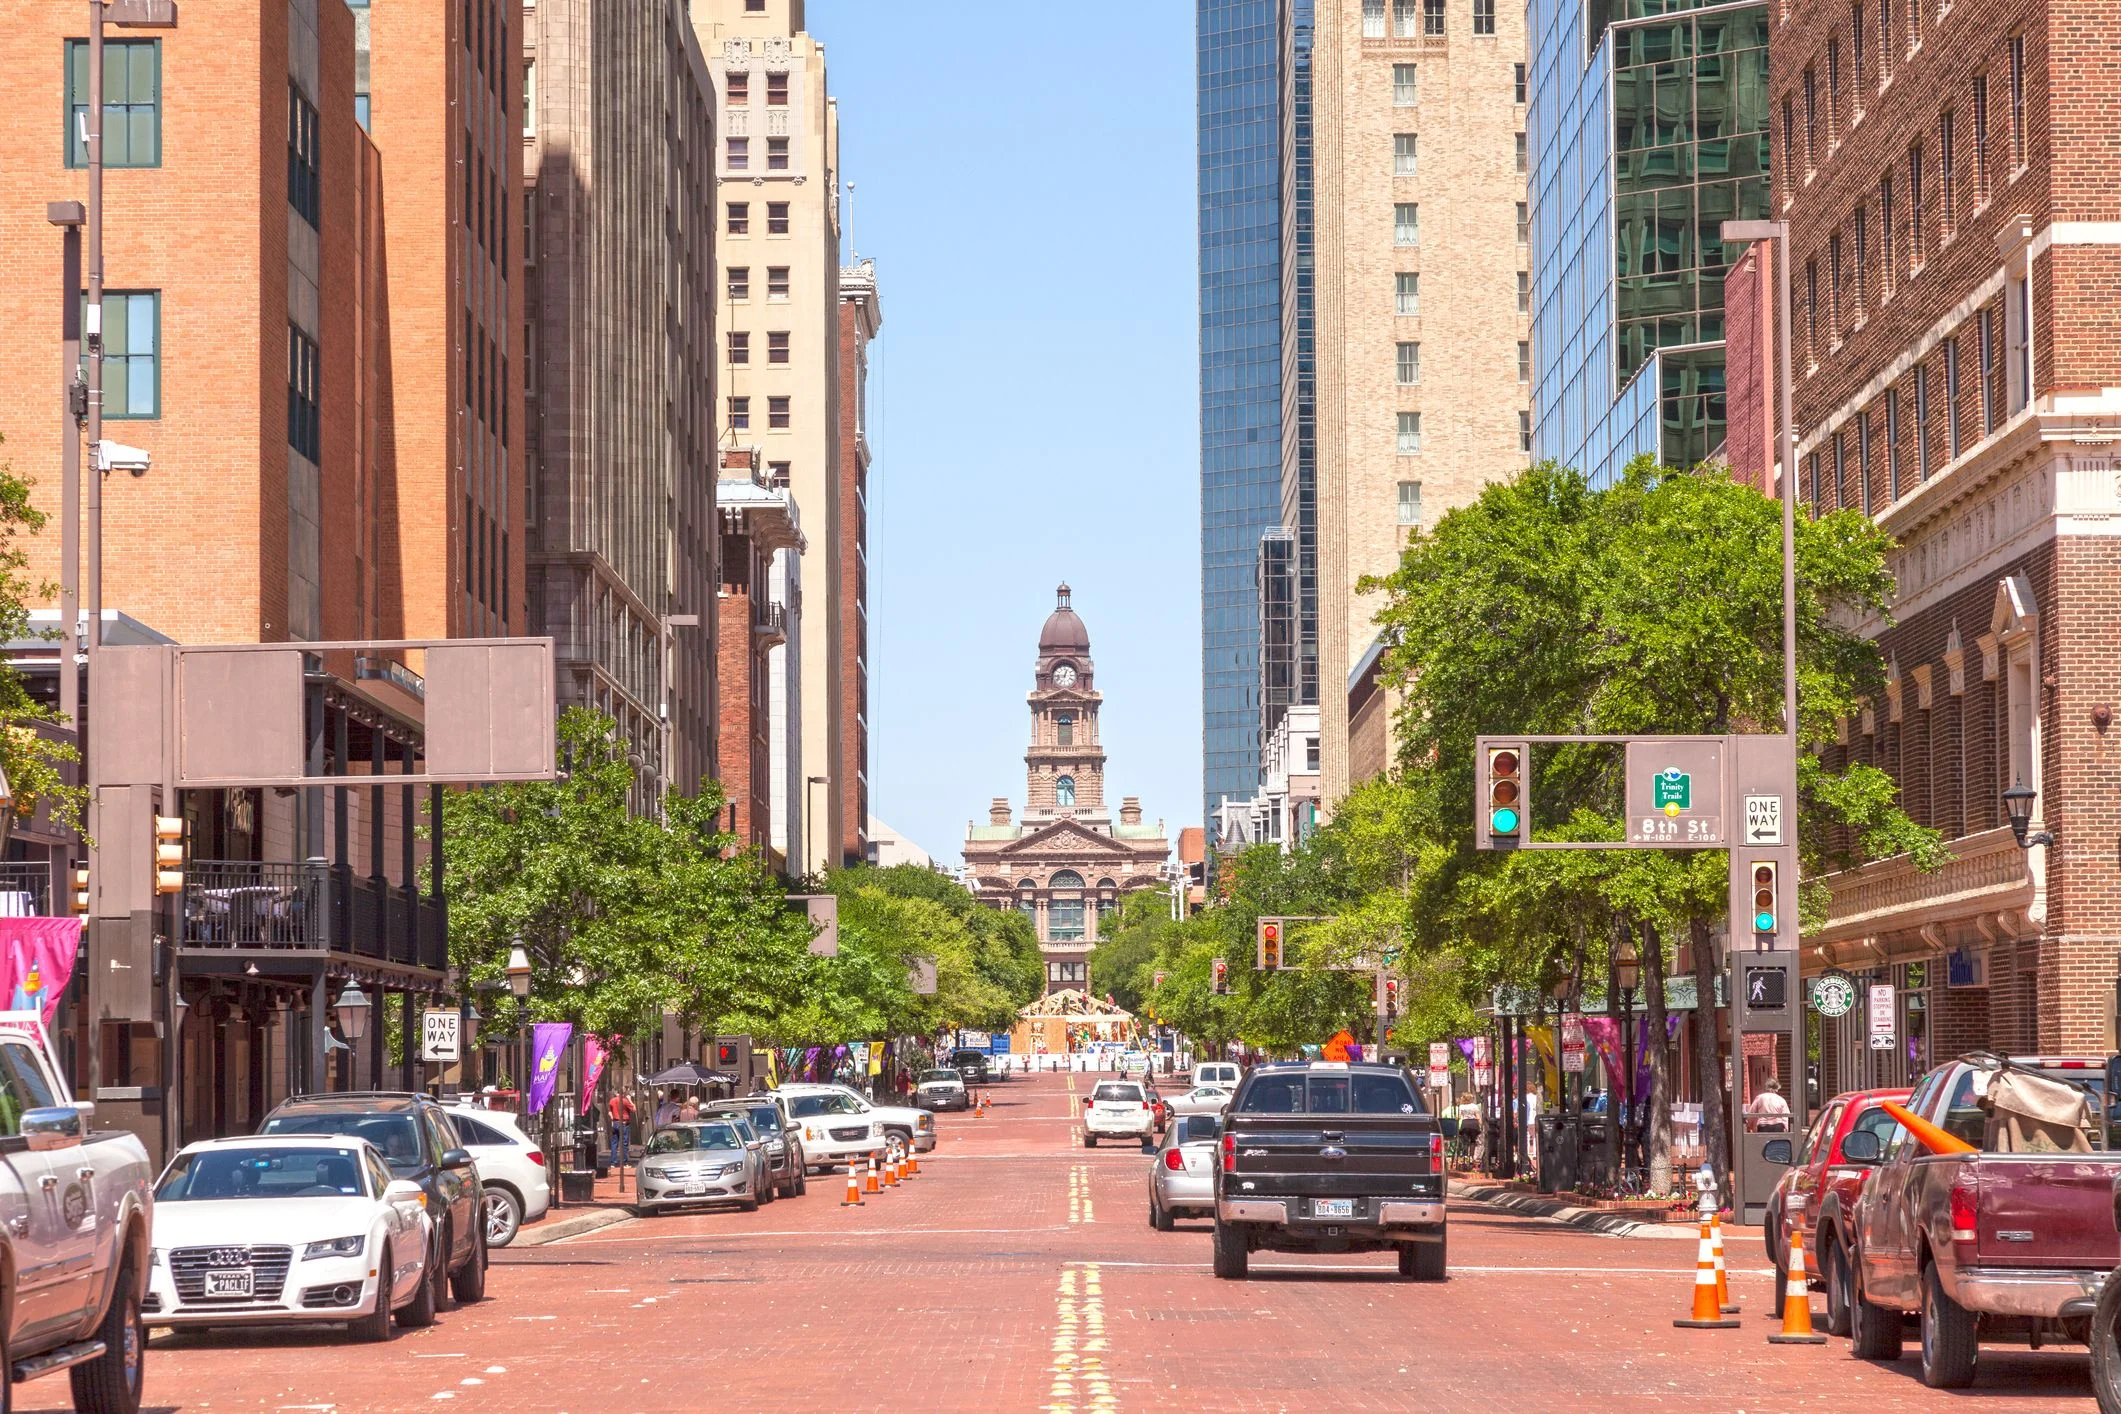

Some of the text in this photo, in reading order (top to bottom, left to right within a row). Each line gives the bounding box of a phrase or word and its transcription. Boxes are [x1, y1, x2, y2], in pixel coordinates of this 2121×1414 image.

[1661, 781, 1684, 792] Trinity
[1662, 792, 1682, 800] Trails
[1749, 801, 1777, 813] ONE
[1642, 818, 1708, 834] 8th St
[1749, 815, 1778, 826] WAY
[1816, 978, 1851, 995] STARBUCKS
[1820, 1003, 1848, 1015] COFFEE
[428, 1017, 456, 1029] ONE
[427, 1031, 456, 1042] WAY
[219, 1279, 250, 1290] PACLIF
